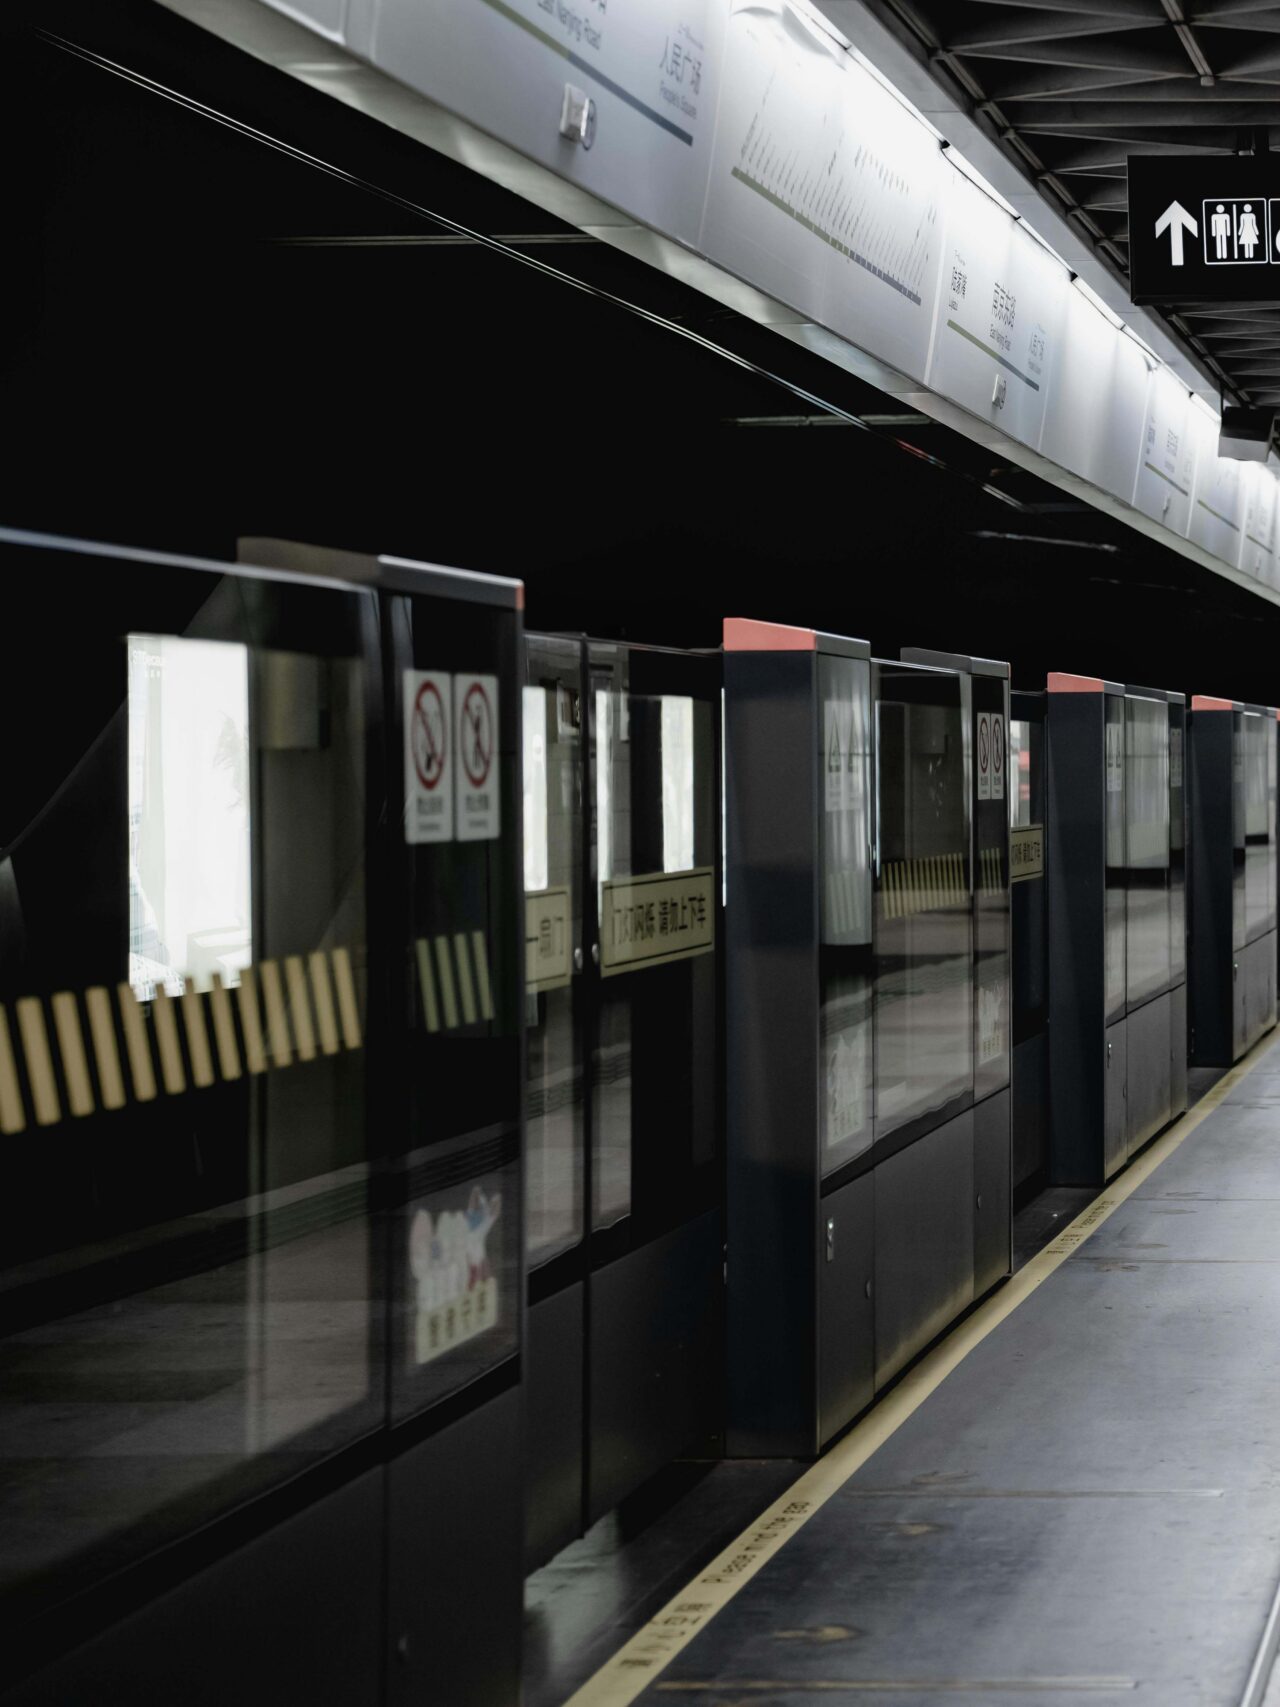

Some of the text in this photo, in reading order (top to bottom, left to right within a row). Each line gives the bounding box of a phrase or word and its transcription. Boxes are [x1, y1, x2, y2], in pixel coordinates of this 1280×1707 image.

[659, 36, 702, 95] 人民广场
[658, 893, 706, 936] 请勿上下车
